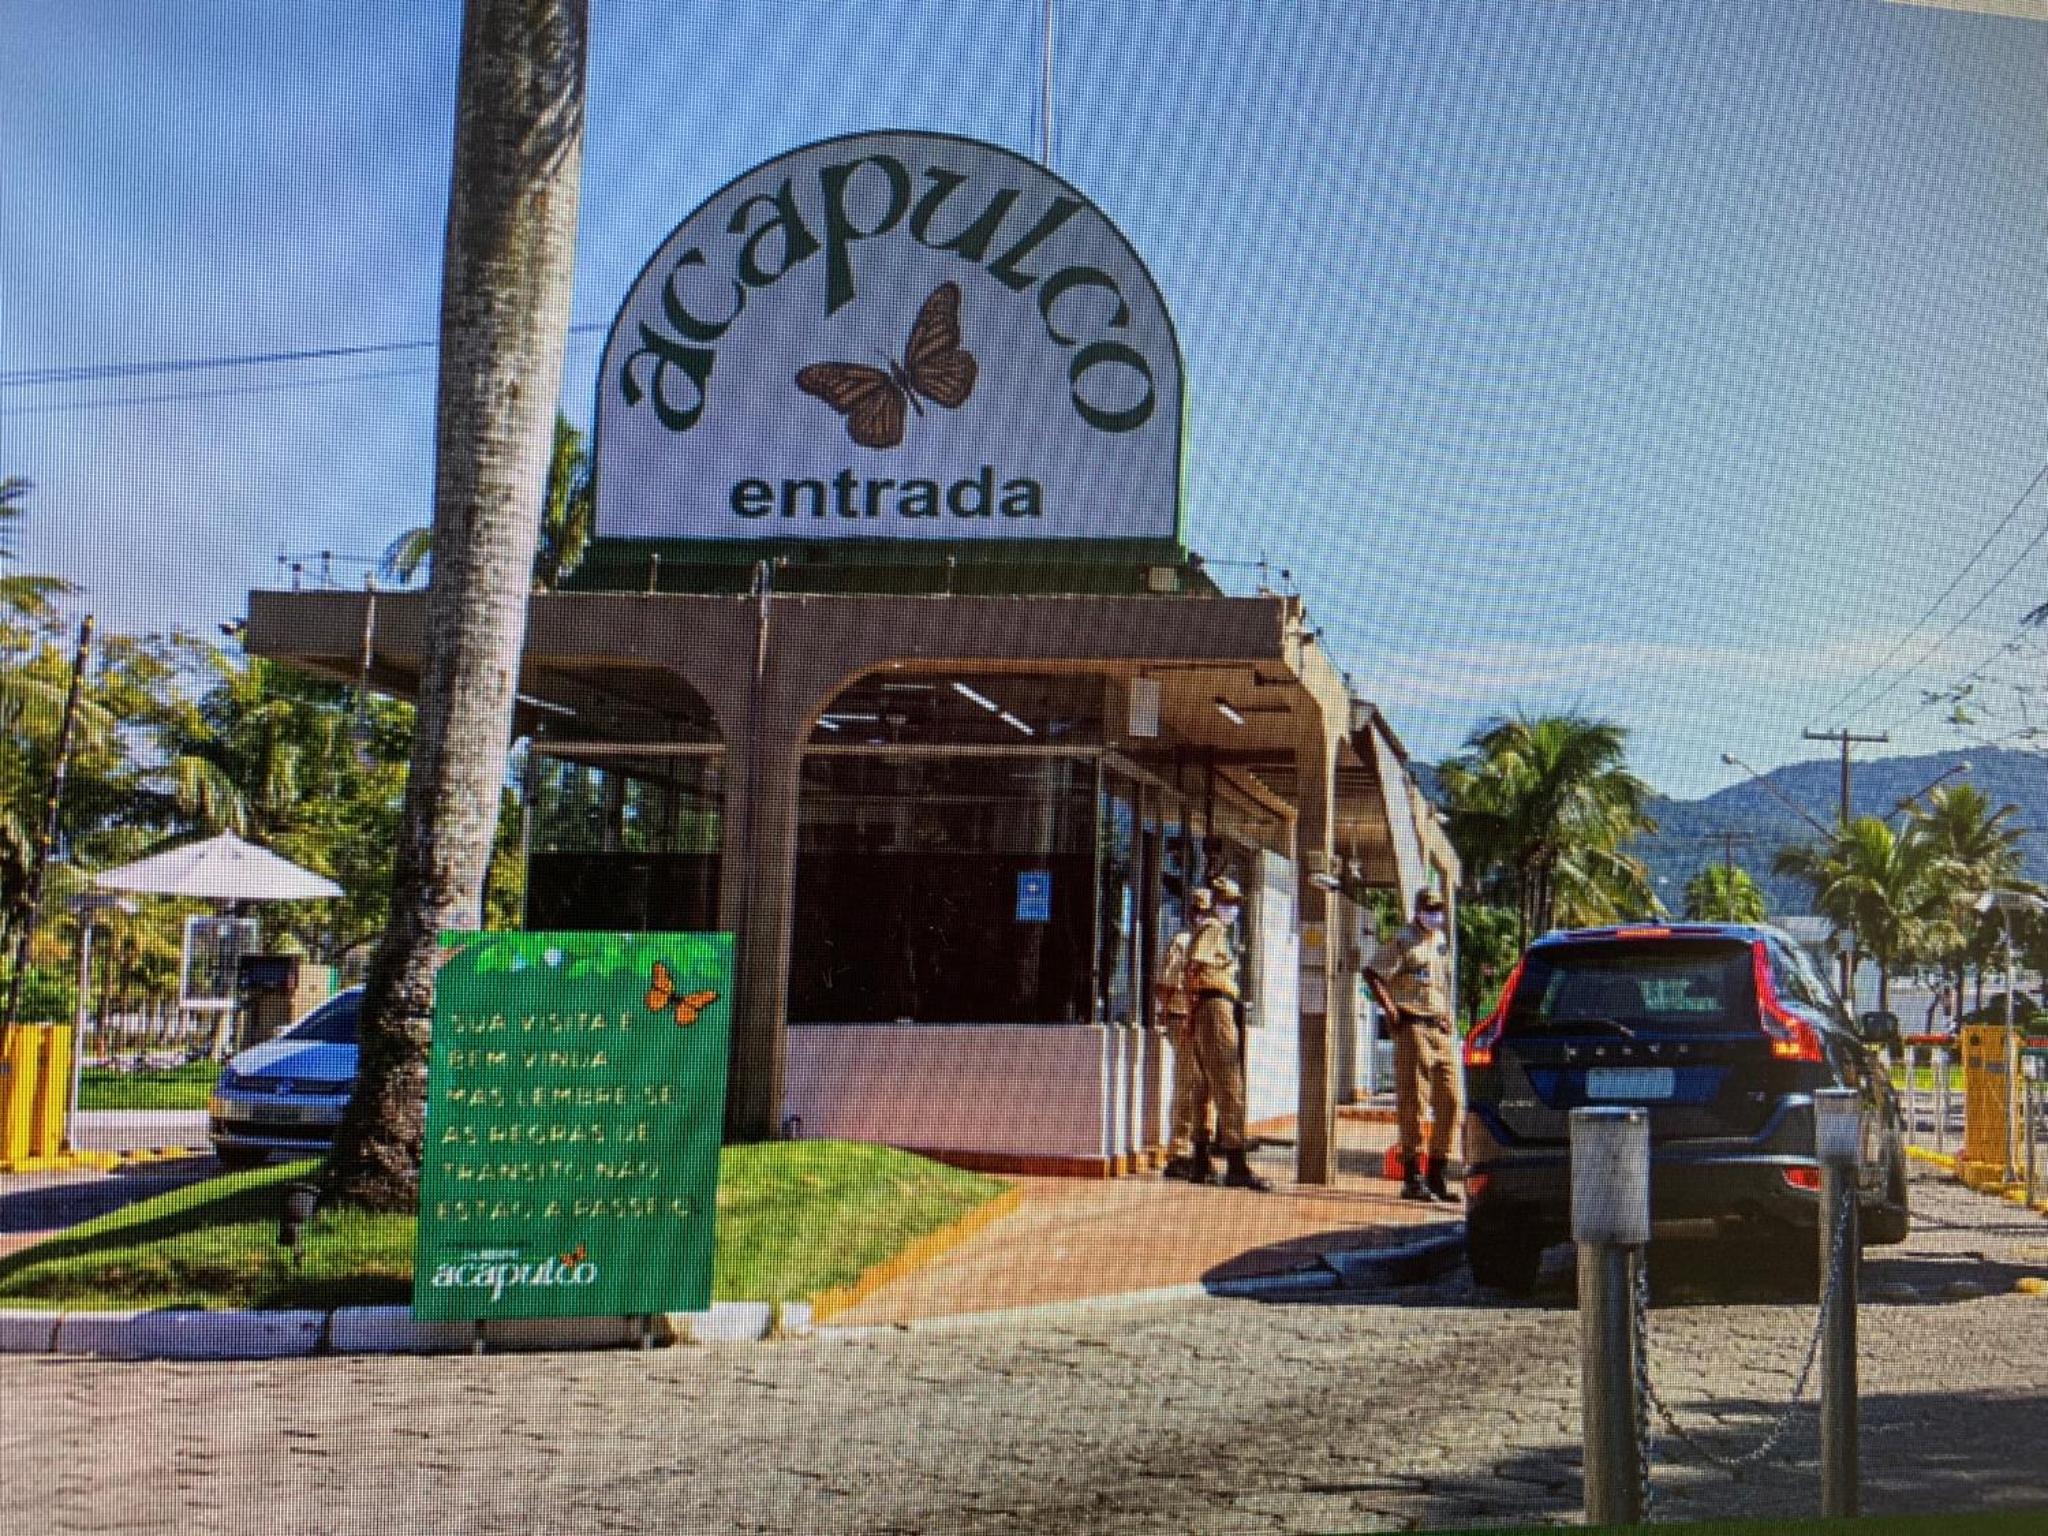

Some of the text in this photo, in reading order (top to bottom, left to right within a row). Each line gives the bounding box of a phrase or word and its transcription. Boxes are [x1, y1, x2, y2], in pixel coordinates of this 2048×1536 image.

[620, 154, 1155, 433] acapulco
[731, 467, 1043, 519] entrada
[449, 1013, 506, 1033] SUA
[522, 1013, 608, 1033] VISITA
[447, 1087, 504, 1107] MAS
[441, 1124, 478, 1145] AS
[489, 1123, 606, 1143] REGRAS
[431, 1256, 599, 1302] acapulco
